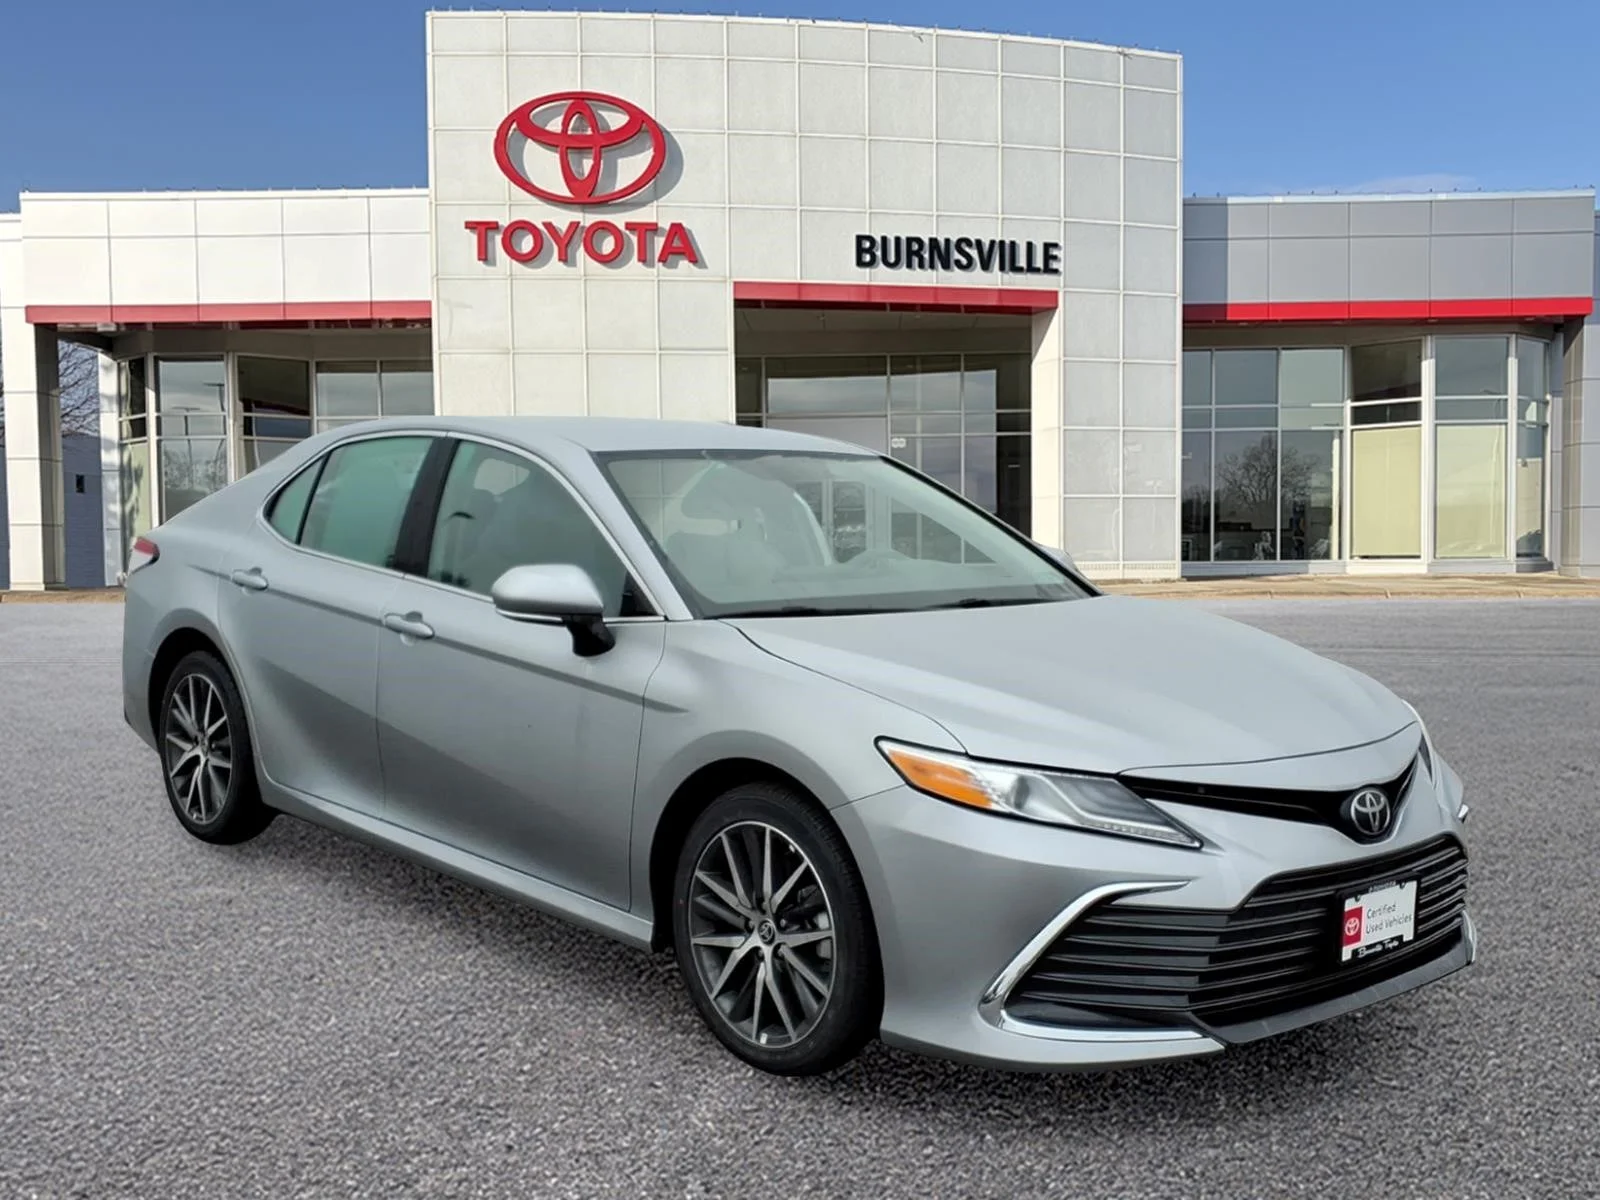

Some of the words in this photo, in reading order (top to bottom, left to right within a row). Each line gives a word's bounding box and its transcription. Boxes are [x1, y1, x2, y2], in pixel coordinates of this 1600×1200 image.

[465, 219, 698, 265] TOYOTA
[855, 234, 1061, 274] BURNSVILLE
[1366, 921, 1384, 934] Used
